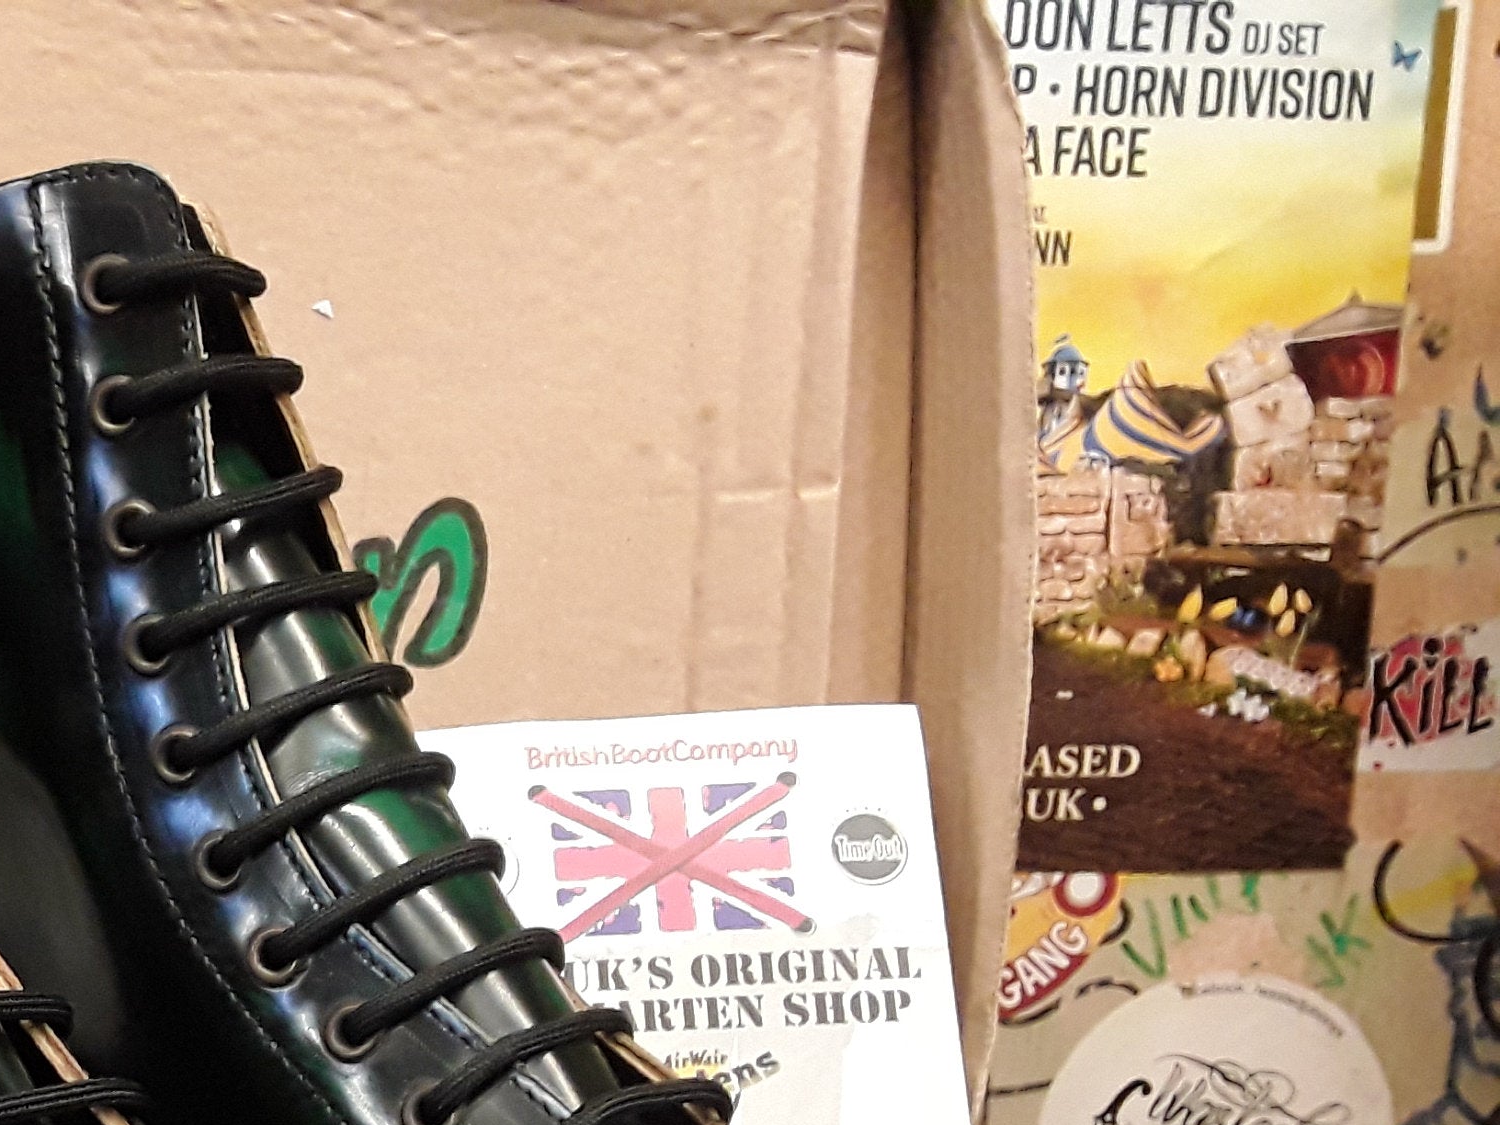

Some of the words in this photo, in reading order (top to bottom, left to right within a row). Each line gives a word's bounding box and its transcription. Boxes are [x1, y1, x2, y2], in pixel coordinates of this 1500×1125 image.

[1106, 0, 1235, 55] LETTS
[1243, 22, 1271, 55] DJ
[1277, 22, 1325, 56] SET
[1073, 63, 1189, 118] HORN
[1198, 67, 1375, 121] DIVISION
[1051, 125, 1151, 178] FACE
[524, 739, 798, 770] BritishBootCompany
[1024, 744, 1141, 779] ASED
[1026, 787, 1088, 823] UK
[690, 946, 922, 988] ORIGINAL
[999, 920, 1089, 1009] GANG
[783, 989, 912, 1026] SHOP
